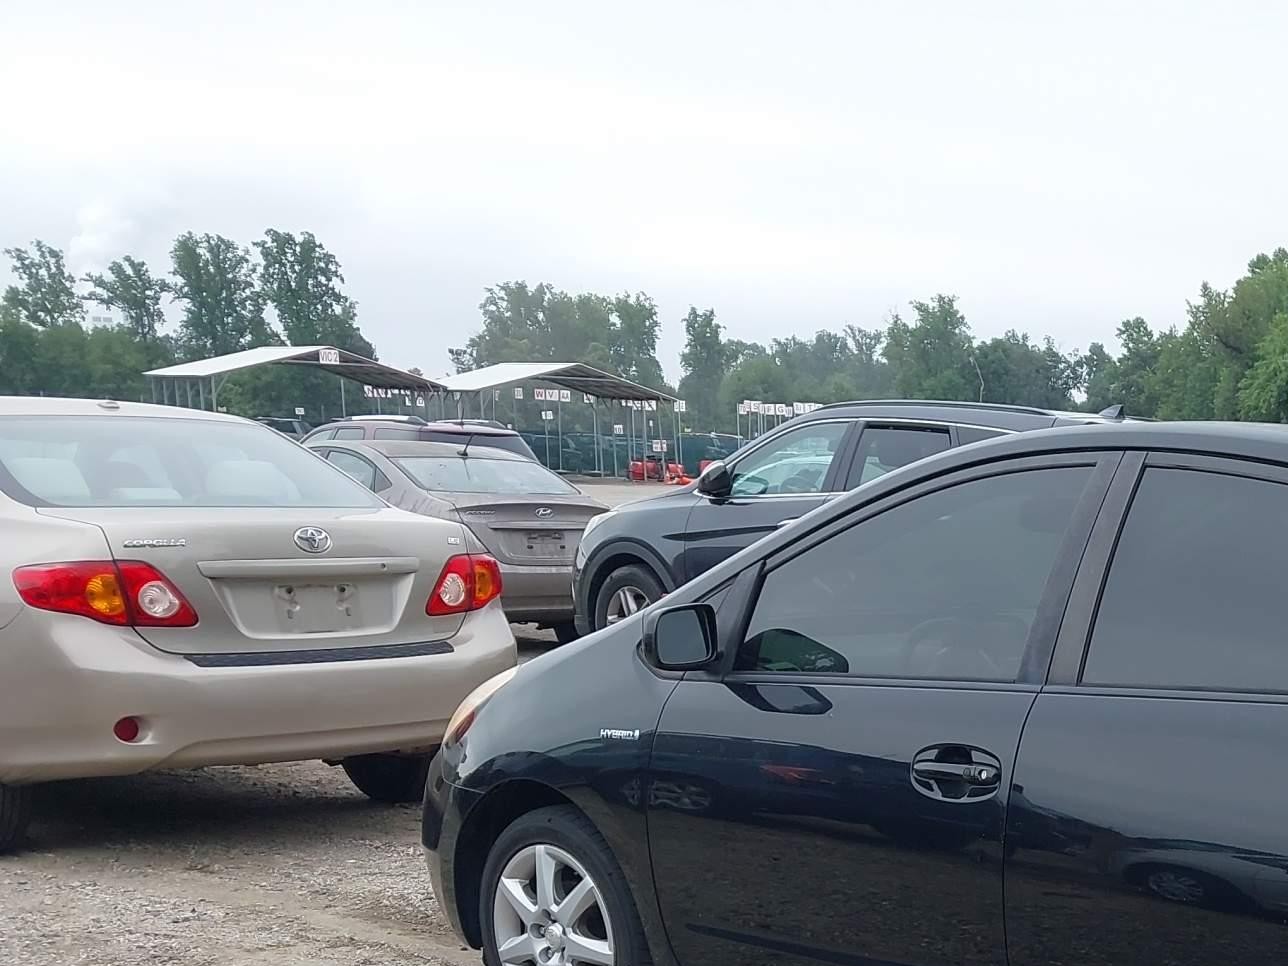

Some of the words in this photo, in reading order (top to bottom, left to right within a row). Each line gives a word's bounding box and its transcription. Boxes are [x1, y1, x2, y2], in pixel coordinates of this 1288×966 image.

[320, 351, 332, 362] VIC
[123, 539, 186, 549] COROLLA
[600, 728, 634, 740] HYBRID
